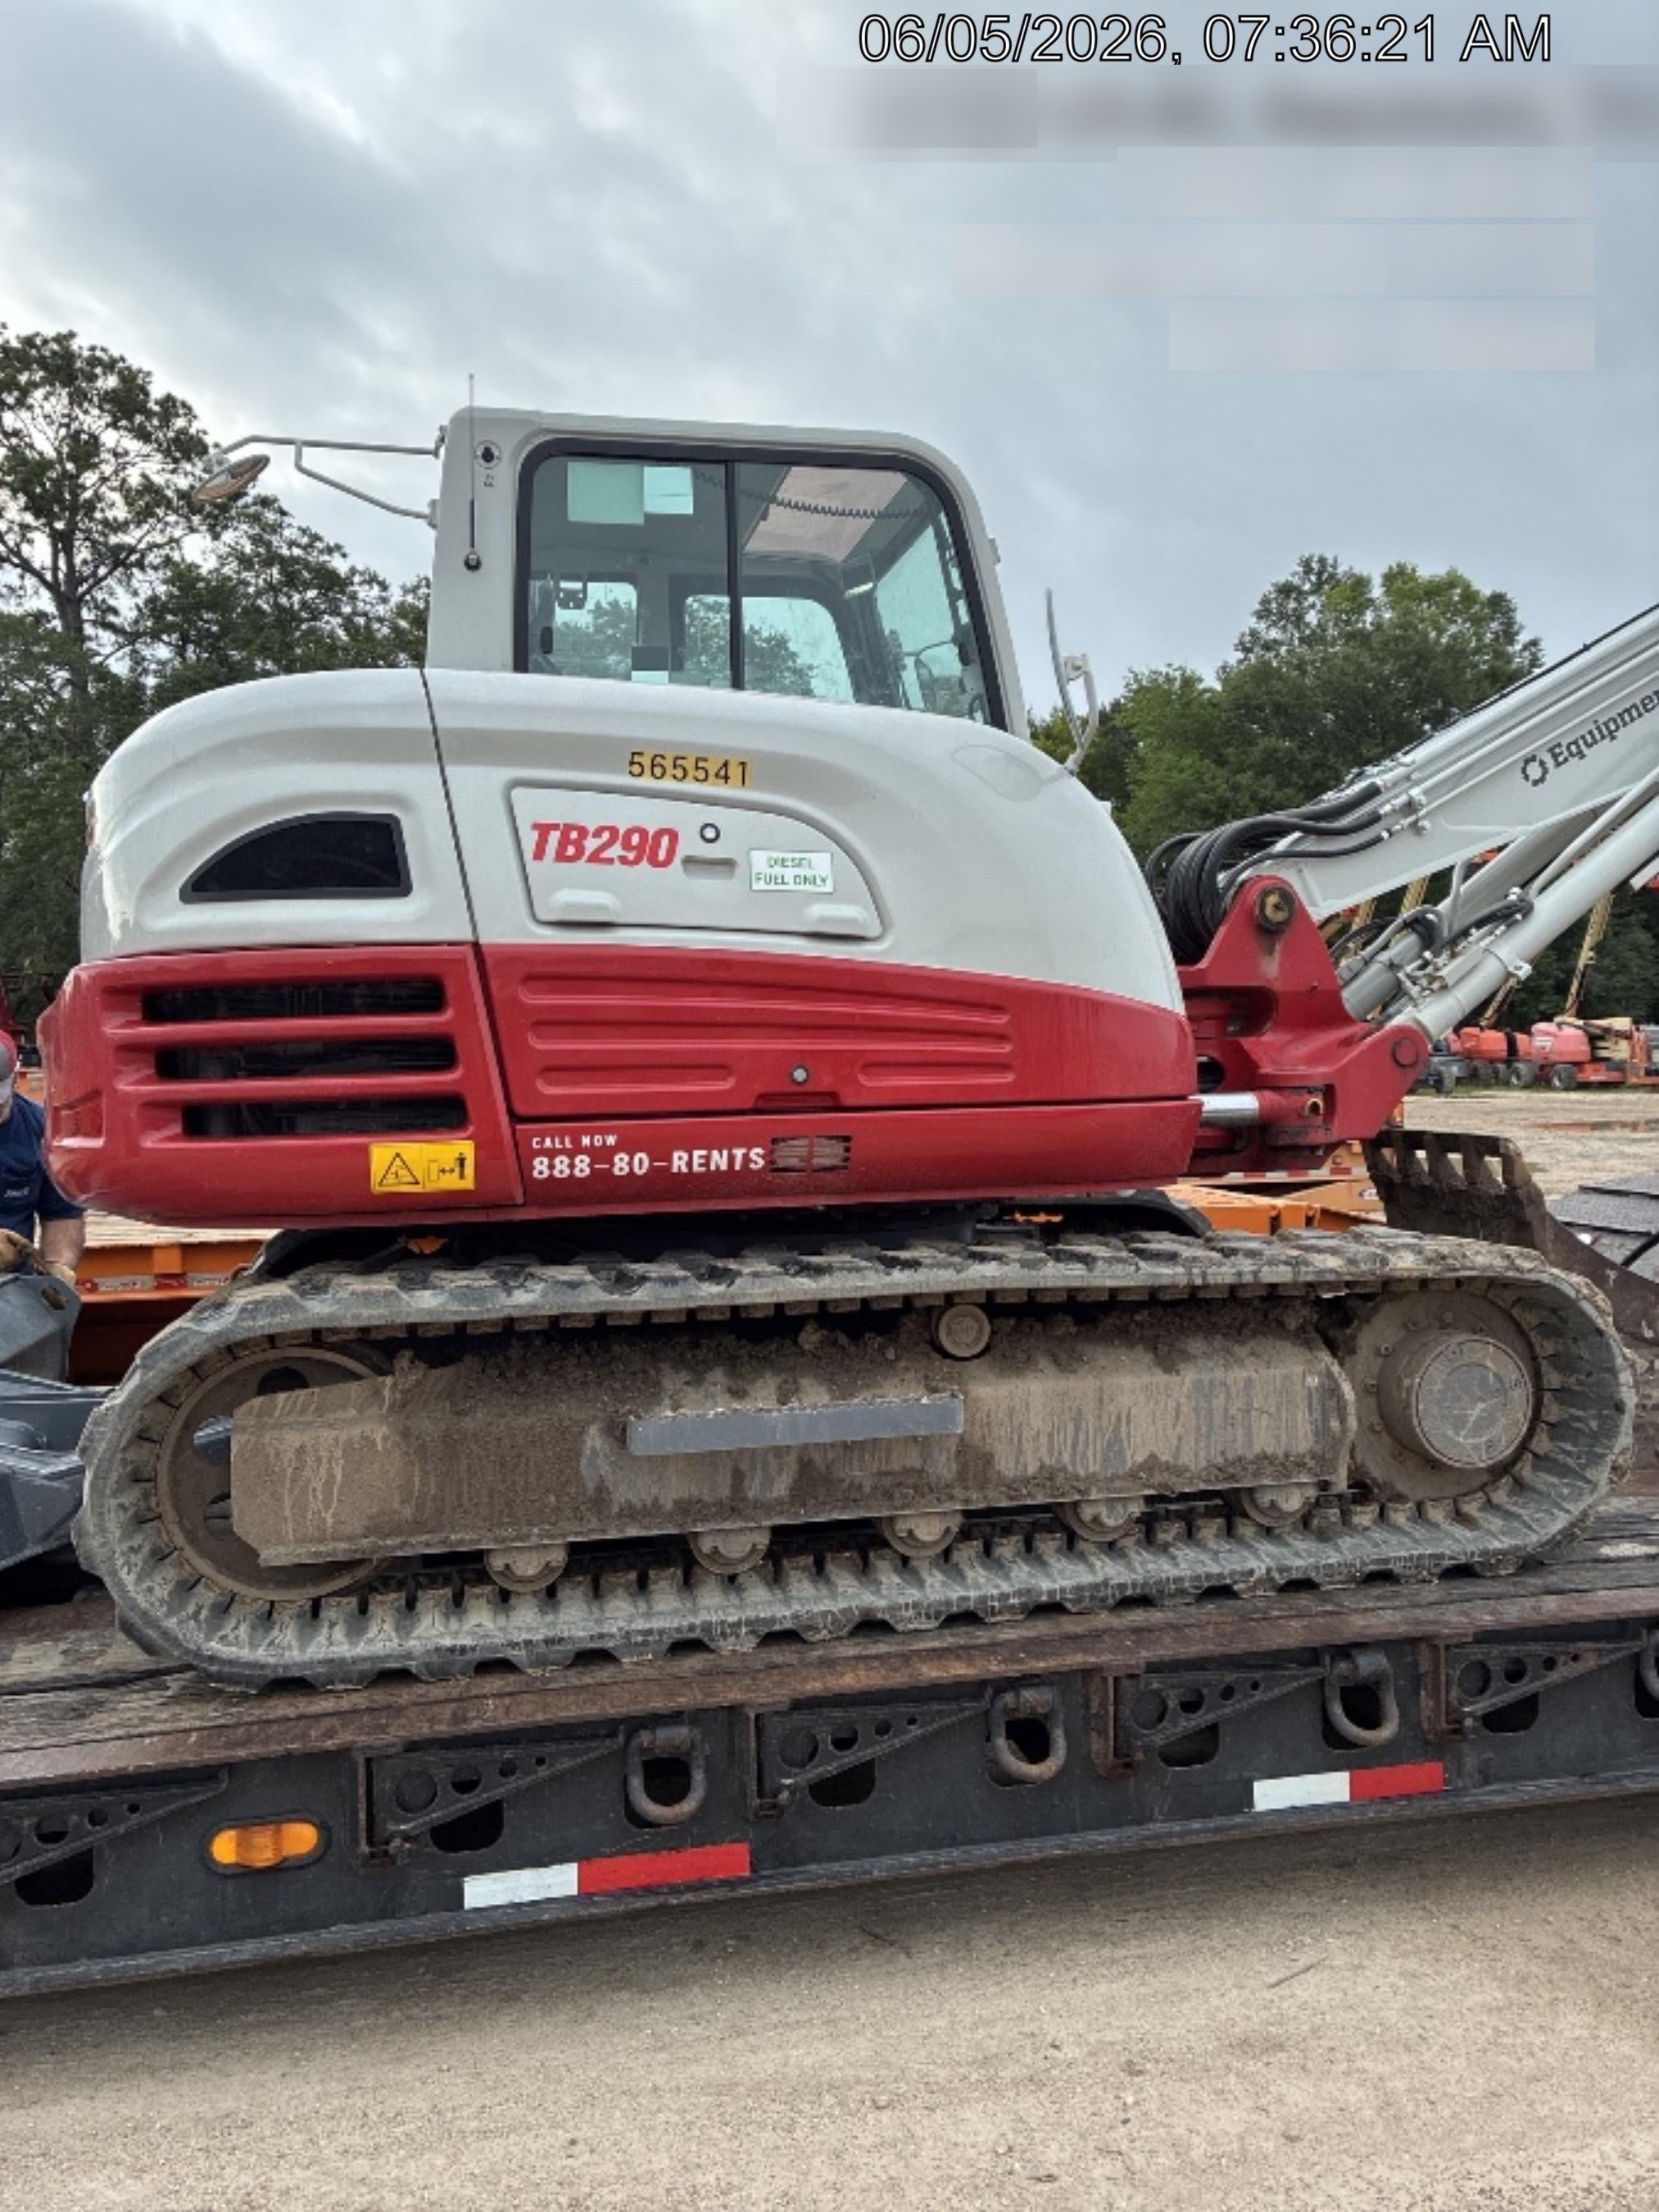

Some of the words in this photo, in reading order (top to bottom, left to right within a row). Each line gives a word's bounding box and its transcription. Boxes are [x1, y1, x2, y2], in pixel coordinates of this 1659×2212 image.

[628, 751, 748, 787] 565541
[530, 822, 679, 868] TB290
[792, 873, 829, 887] ONLY
[533, 1136, 573, 1149] CALL
[581, 1135, 617, 1147] NOW
[533, 1147, 765, 1179] 888-80-RENTS
